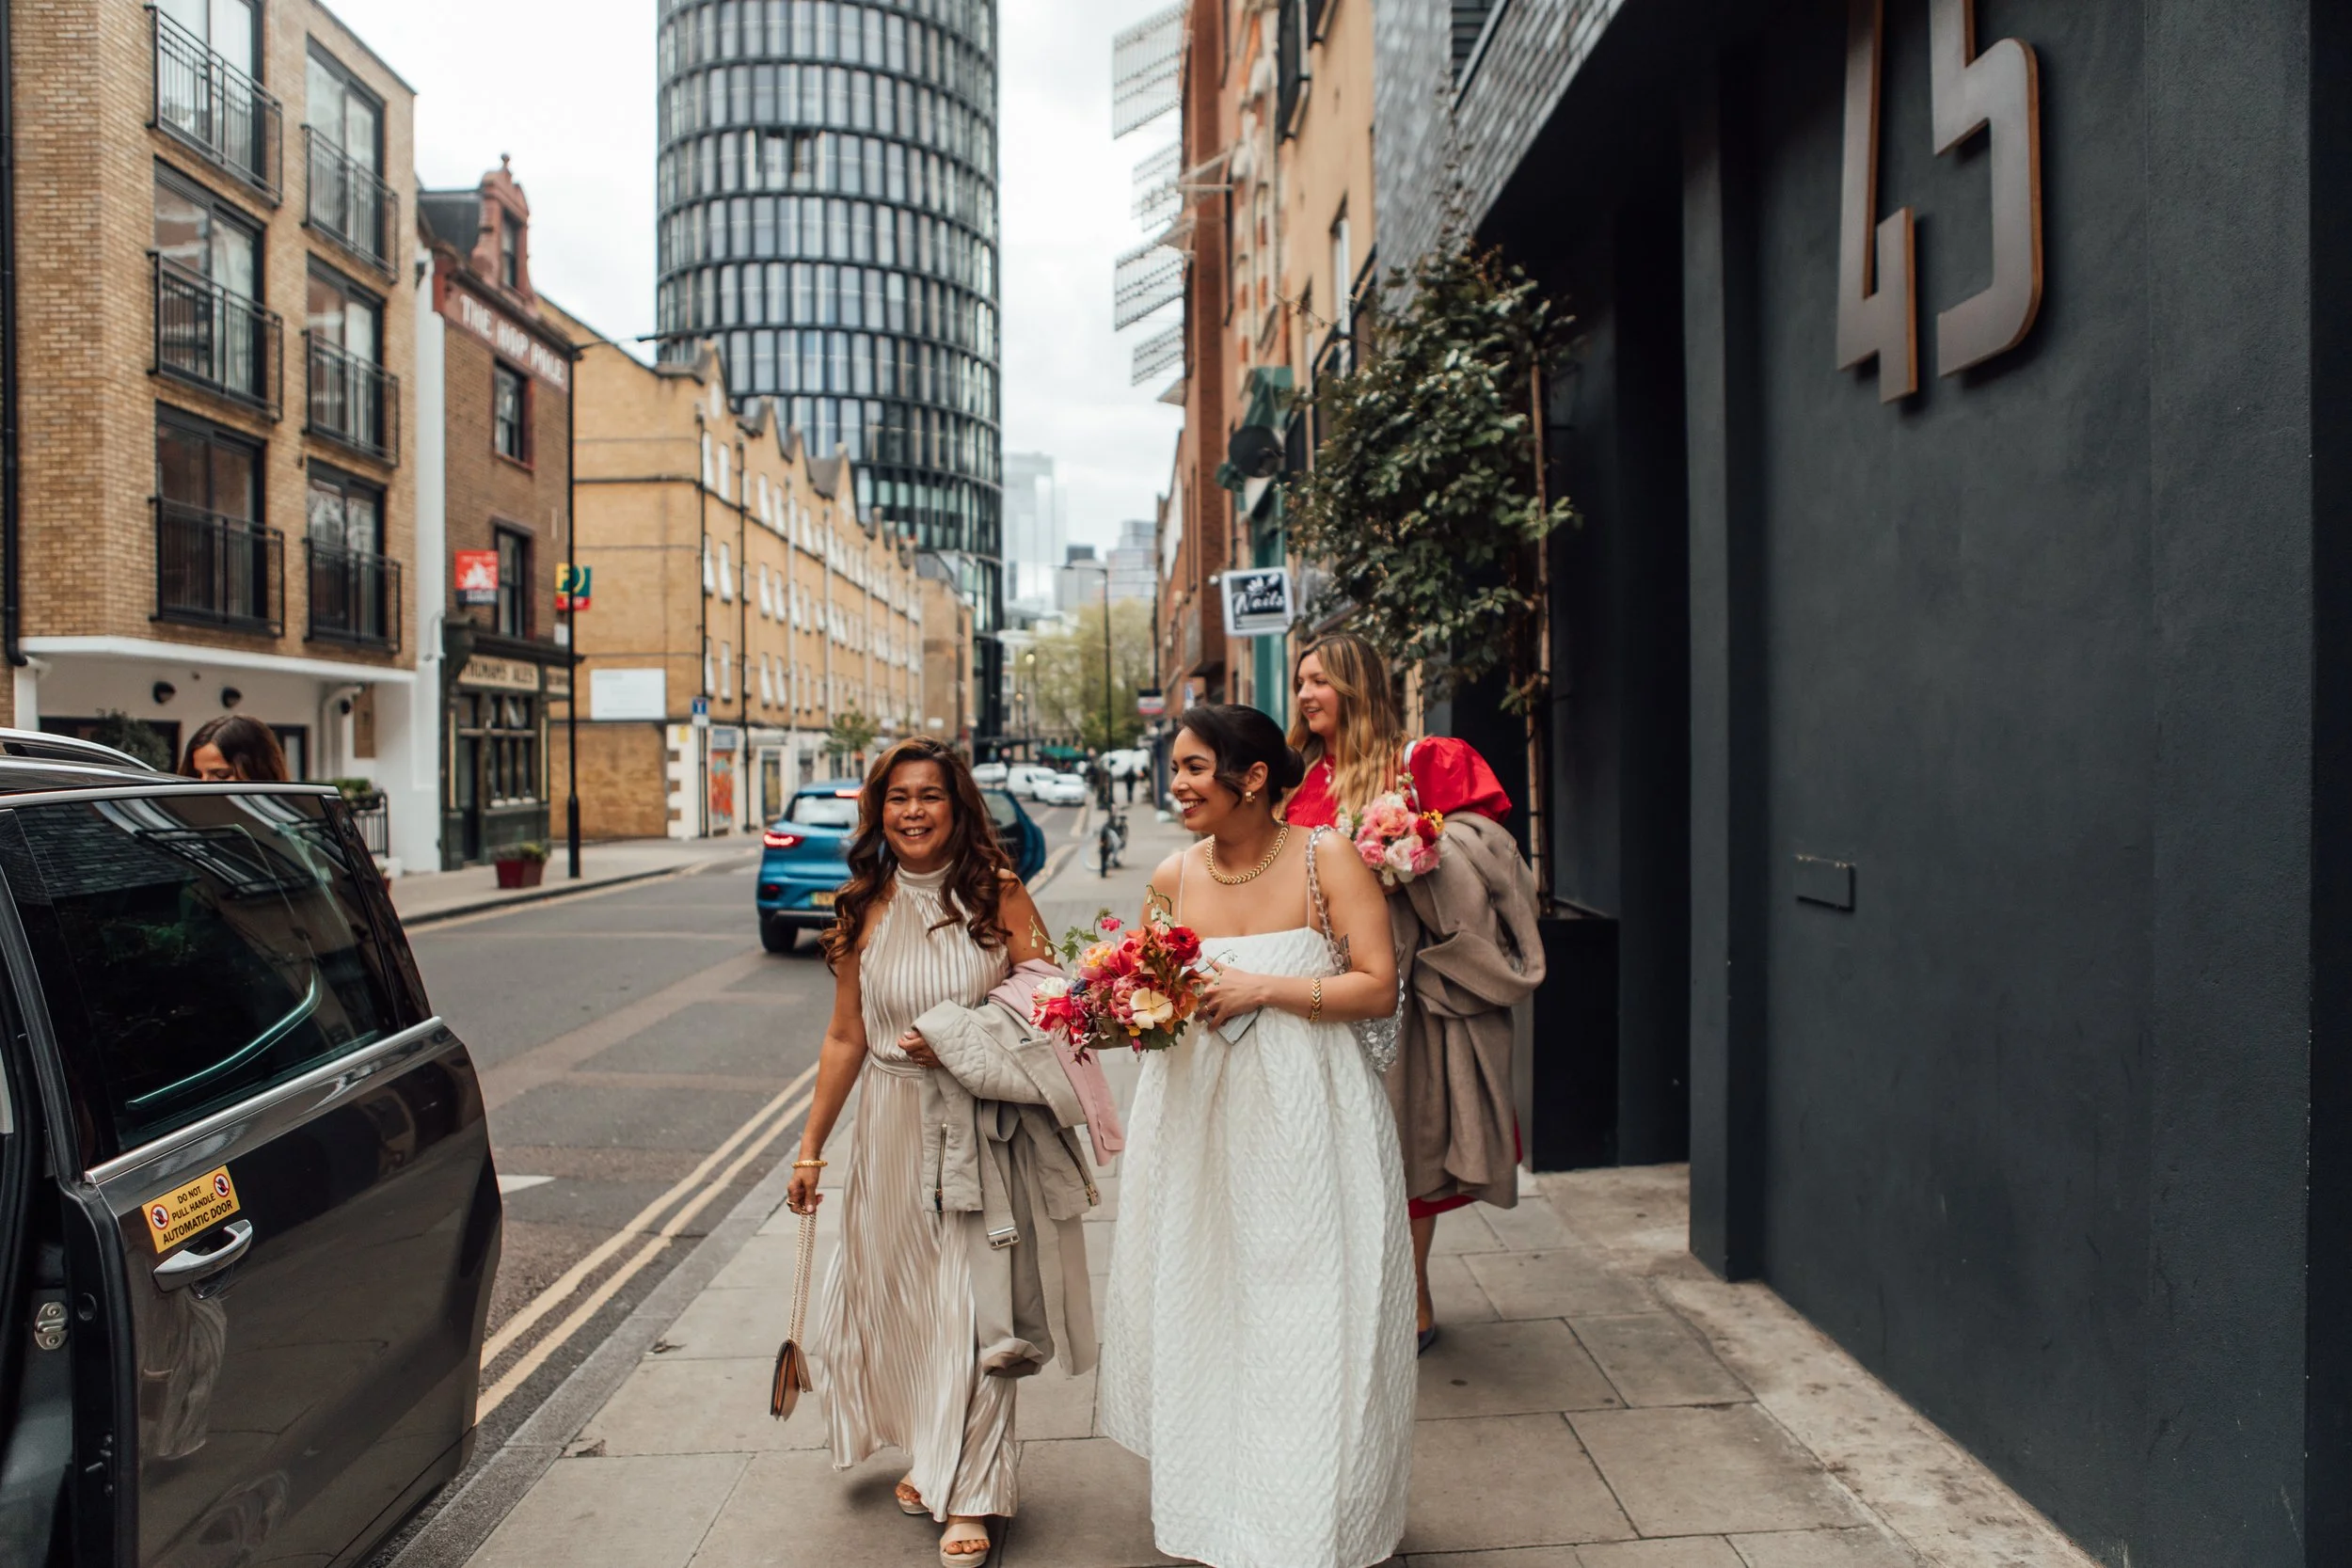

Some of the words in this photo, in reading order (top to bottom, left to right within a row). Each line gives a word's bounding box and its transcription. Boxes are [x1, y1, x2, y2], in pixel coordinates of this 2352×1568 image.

[1836, 0, 2042, 404] 45
[171, 1209, 189, 1221] PULL
[189, 1193, 215, 1212] HANDLE
[177, 1193, 188, 1204] DO
[188, 1185, 201, 1199] NOT
[163, 1212, 210, 1244] AUTOMATIC
[210, 1199, 232, 1219] DOOR
